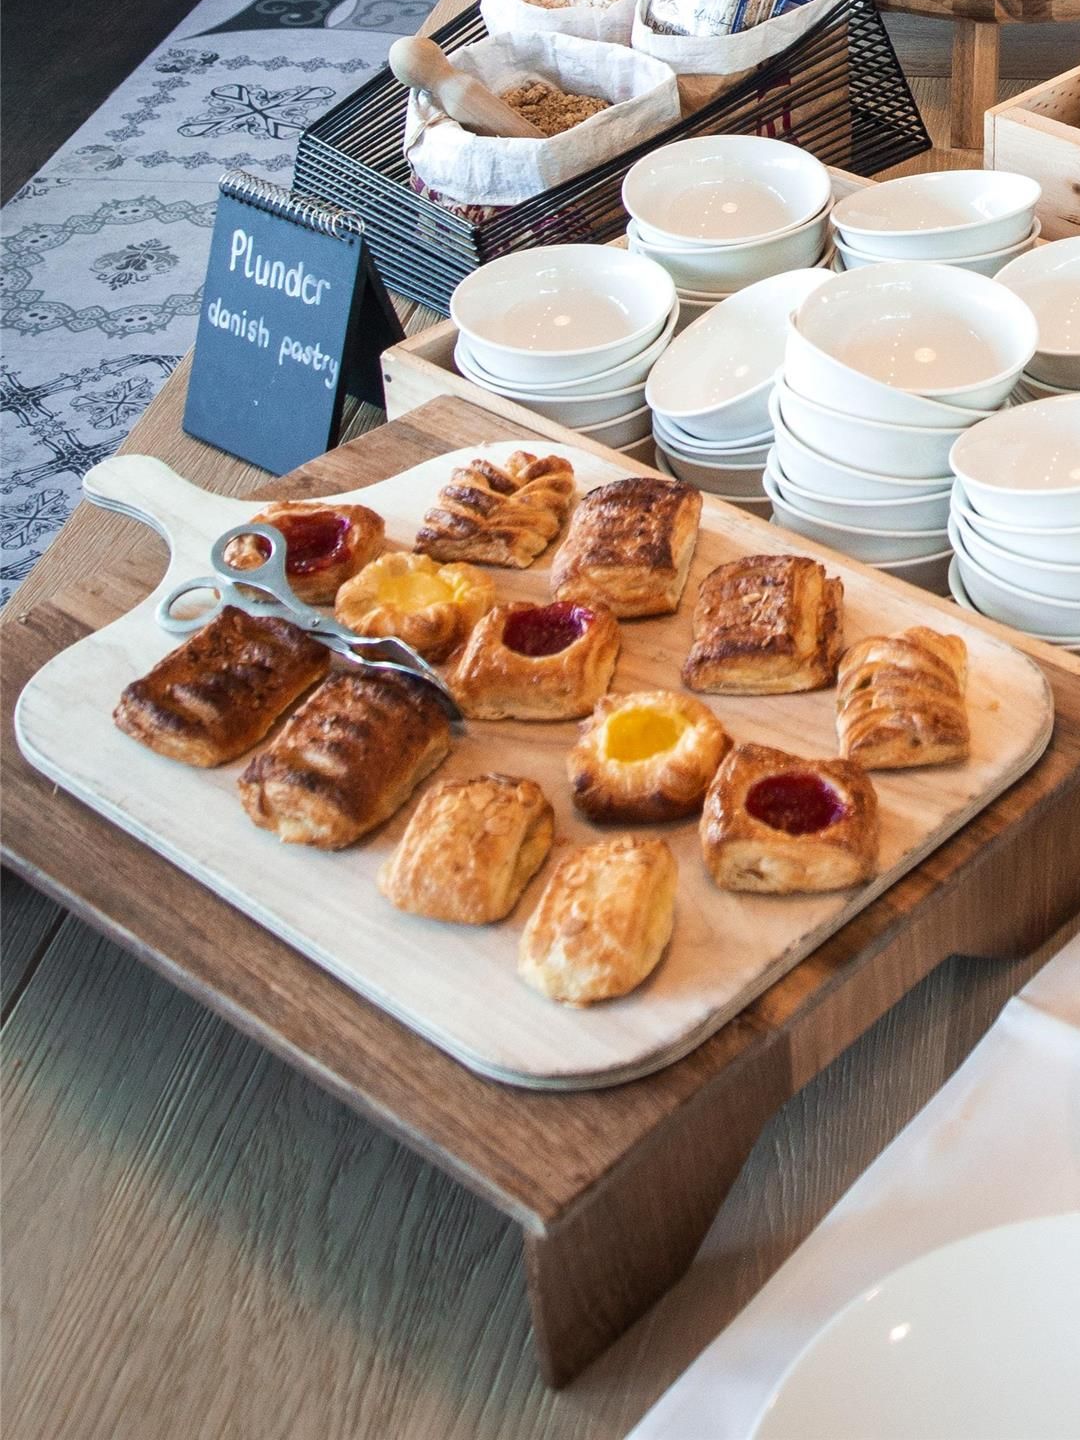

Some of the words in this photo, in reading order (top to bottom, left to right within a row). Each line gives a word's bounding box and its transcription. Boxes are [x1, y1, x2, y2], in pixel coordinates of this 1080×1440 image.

[229, 228, 332, 306] Plunder
[207, 297, 270, 348] danish
[278, 335, 338, 390] pastry
